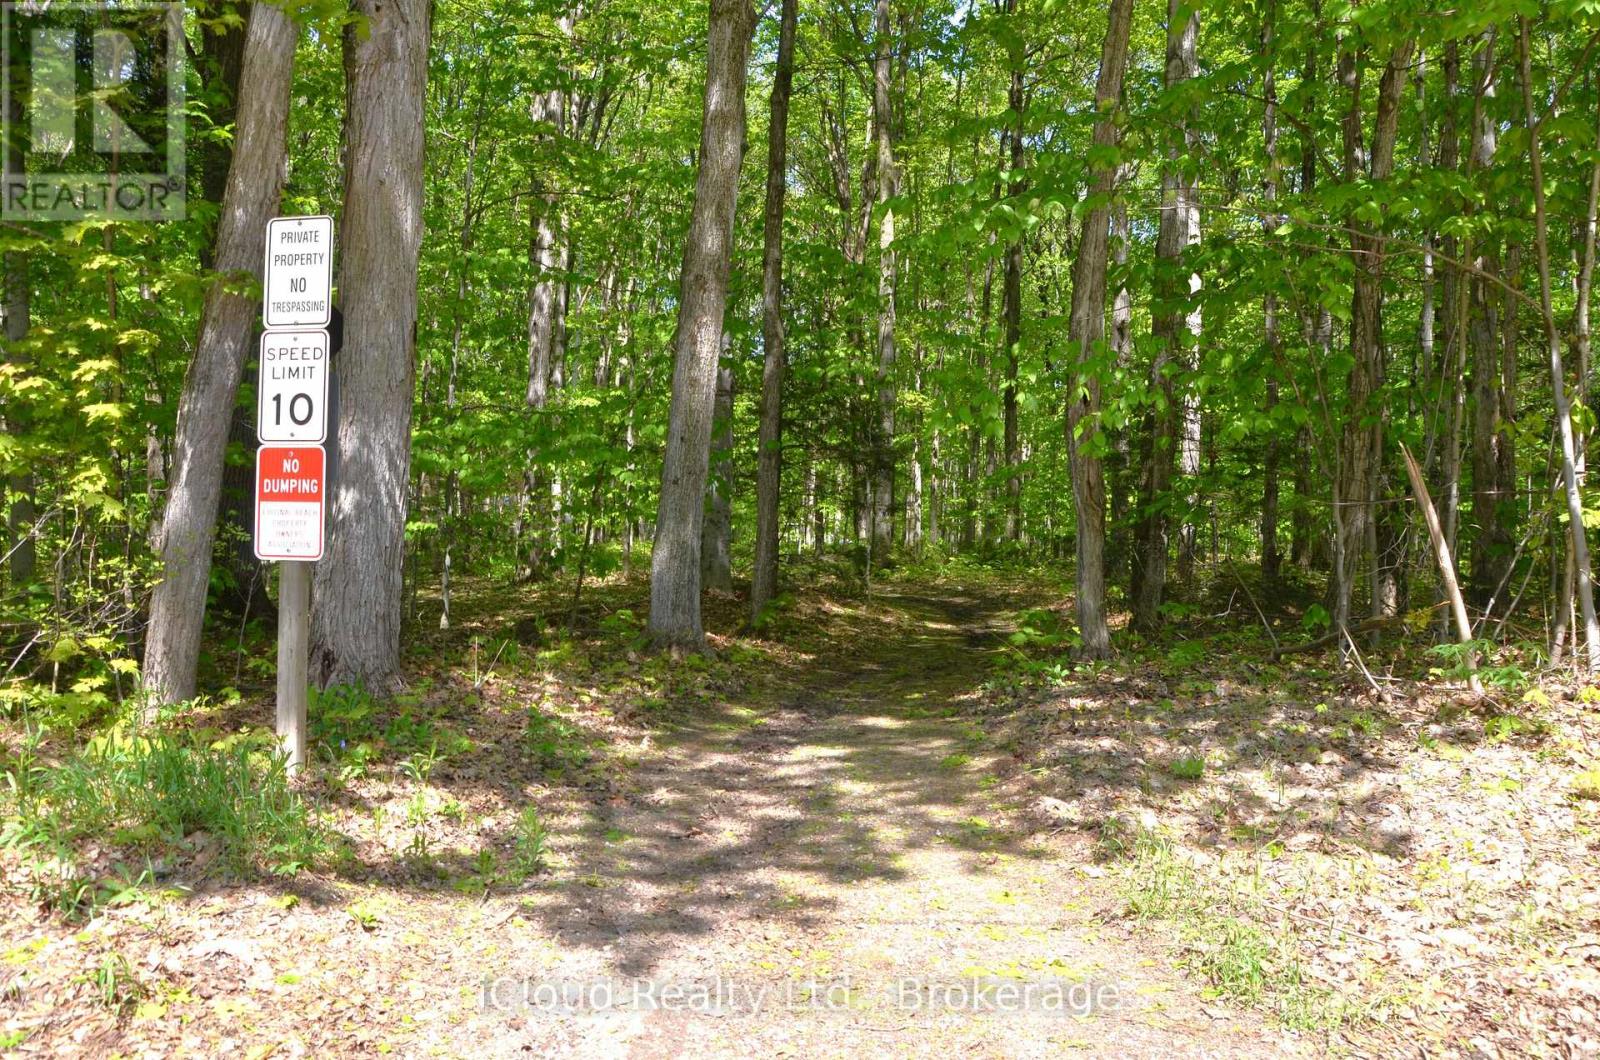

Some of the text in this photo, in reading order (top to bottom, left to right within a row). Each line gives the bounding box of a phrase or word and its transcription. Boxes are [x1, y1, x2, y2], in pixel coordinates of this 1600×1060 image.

[280, 230, 320, 244] PRIVATE
[274, 252, 325, 267] PROPERTY
[290, 277, 307, 293] NO
[272, 300, 325, 313] TRESPASSING
[267, 347, 324, 361] SPEED
[272, 366, 316, 380] LIMIT
[272, 392, 314, 426] 10
[282, 458, 300, 474] NO
[263, 478, 319, 494] DUMPING
